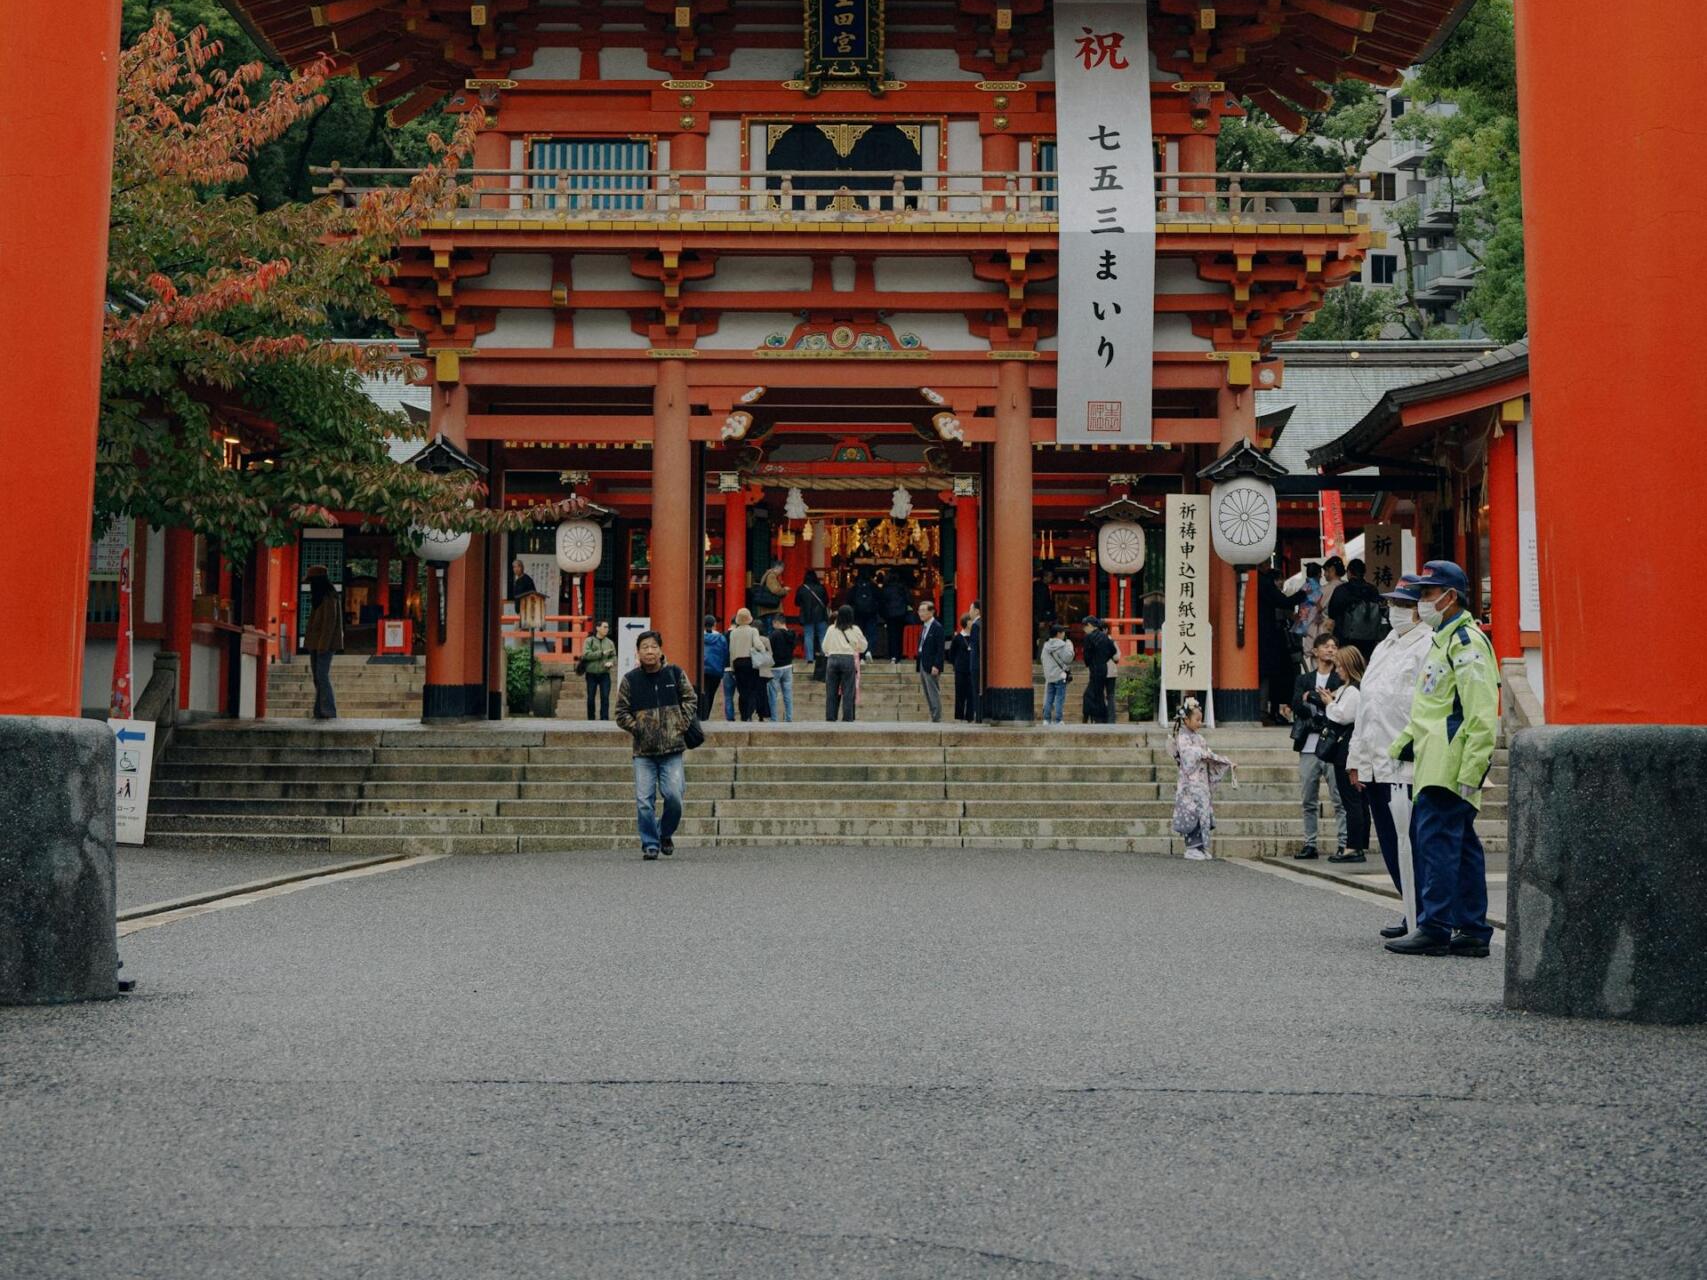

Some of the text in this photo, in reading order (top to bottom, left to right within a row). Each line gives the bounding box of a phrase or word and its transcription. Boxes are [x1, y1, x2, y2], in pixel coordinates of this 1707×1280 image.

[1074, 24, 1129, 369] 祝 七五三まいり
[1177, 502, 1198, 678] 祈祷申込用紙記入所
[1372, 535, 1393, 588] 祈祷
